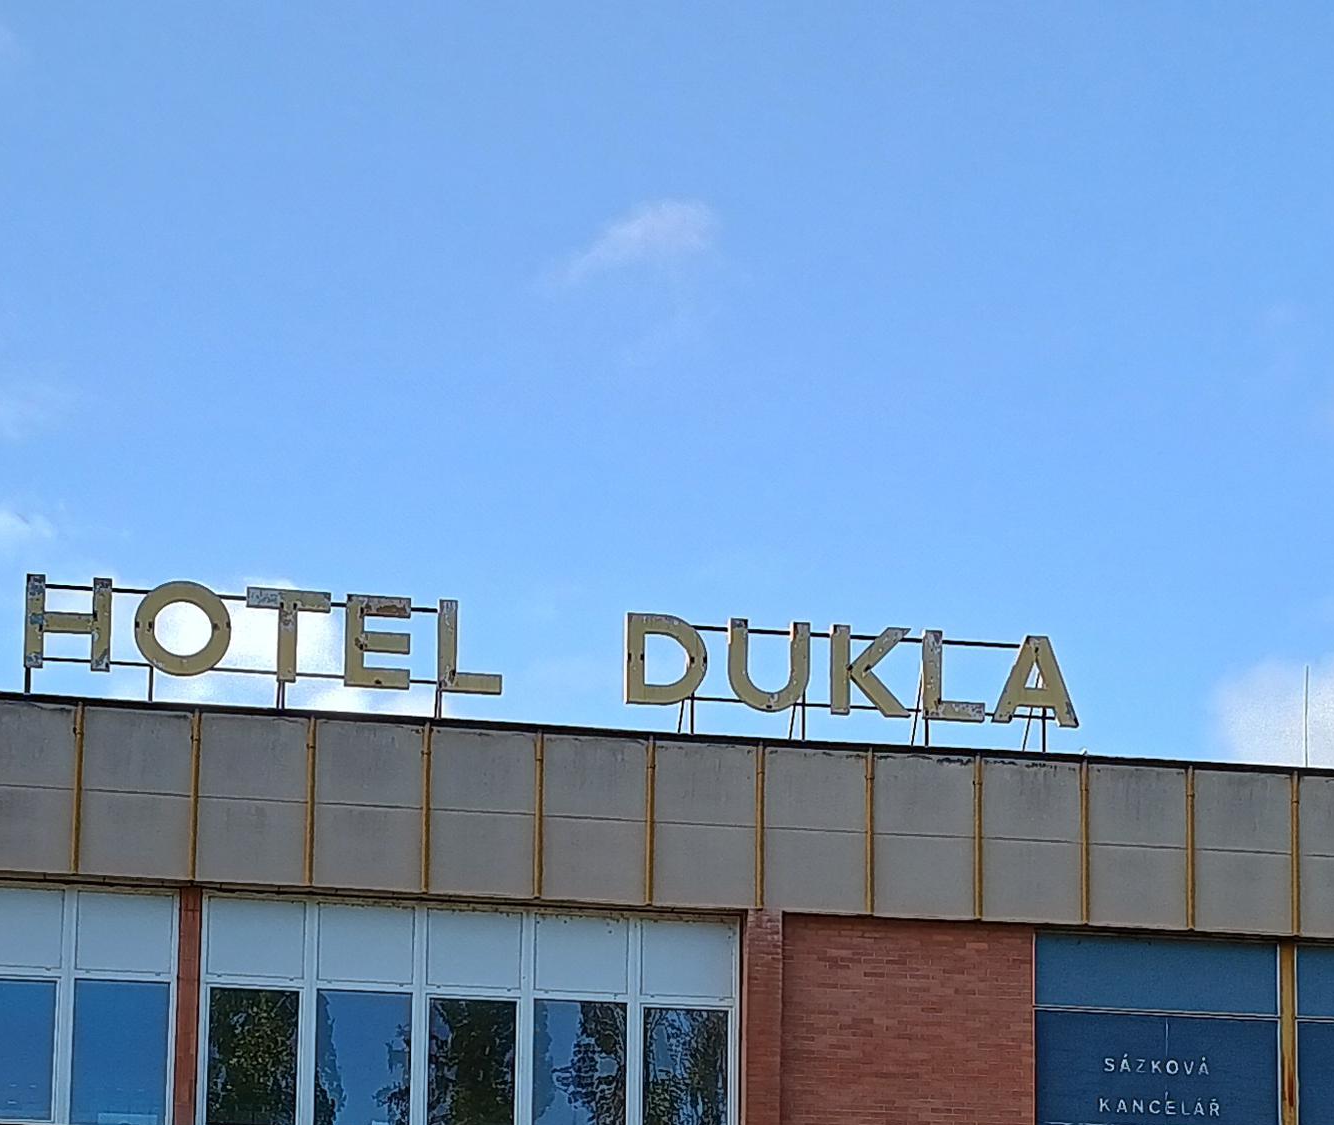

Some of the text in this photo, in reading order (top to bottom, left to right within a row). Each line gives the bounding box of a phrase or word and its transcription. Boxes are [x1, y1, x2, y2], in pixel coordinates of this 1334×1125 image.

[24, 573, 1079, 728] HOTEL DUKLA
[1103, 1053, 1210, 1076] SÁZKOVÁ
[1098, 1097, 1220, 1117] KANCELÁŘ
